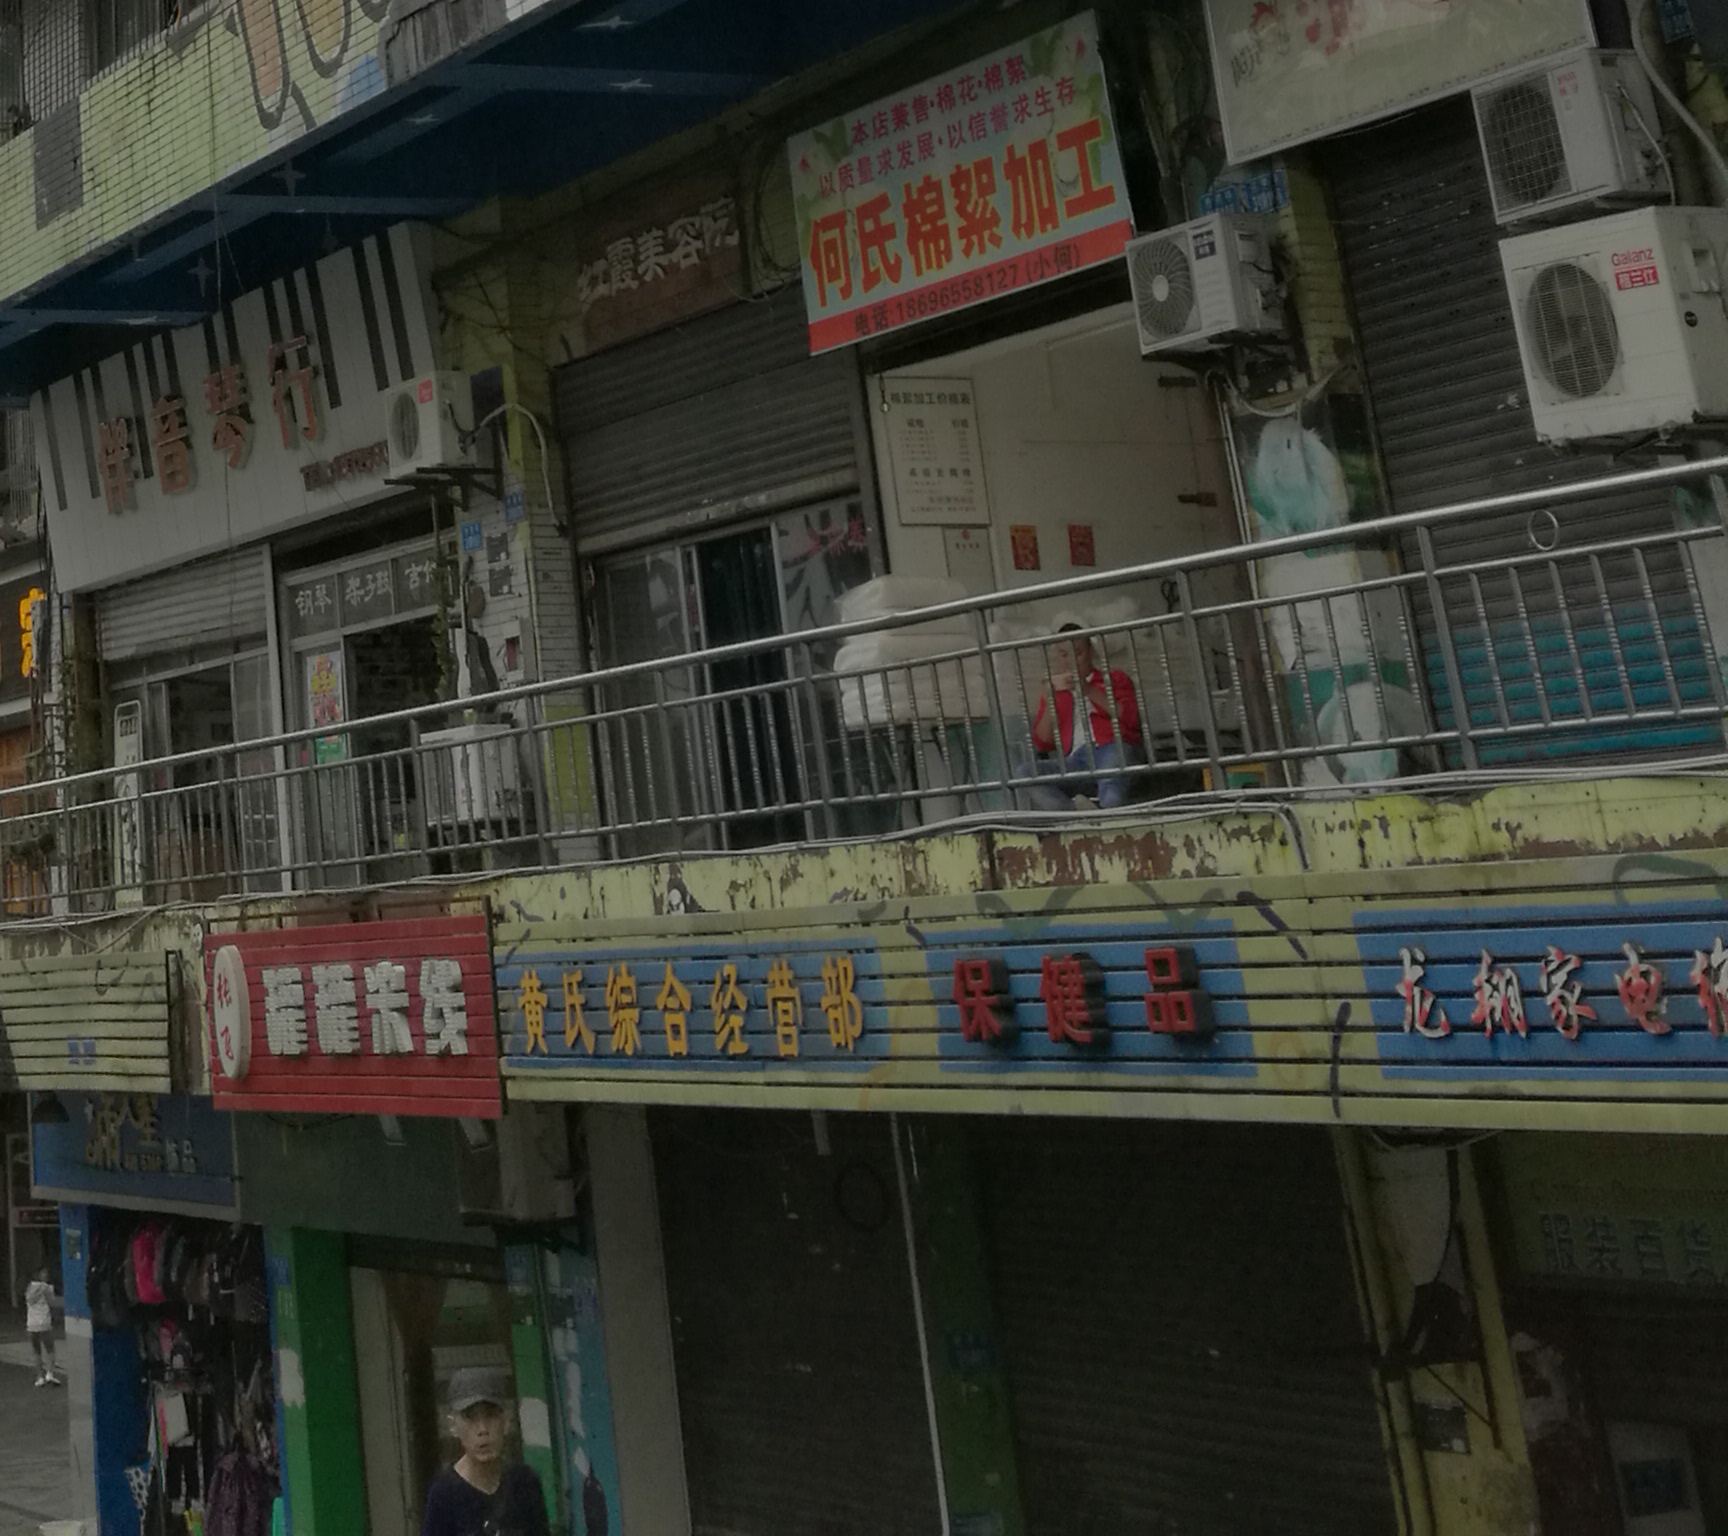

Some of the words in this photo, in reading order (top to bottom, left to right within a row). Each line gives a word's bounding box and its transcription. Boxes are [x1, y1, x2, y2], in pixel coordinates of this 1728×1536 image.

[810, 119, 1117, 307] 何氏棉絮加工
[1611, 248, 1654, 266] Galanz
[261, 959, 469, 1056] 罐罐米线
[519, 956, 863, 1056] 黄氏综合经营部
[953, 947, 1198, 1043] 保健品
